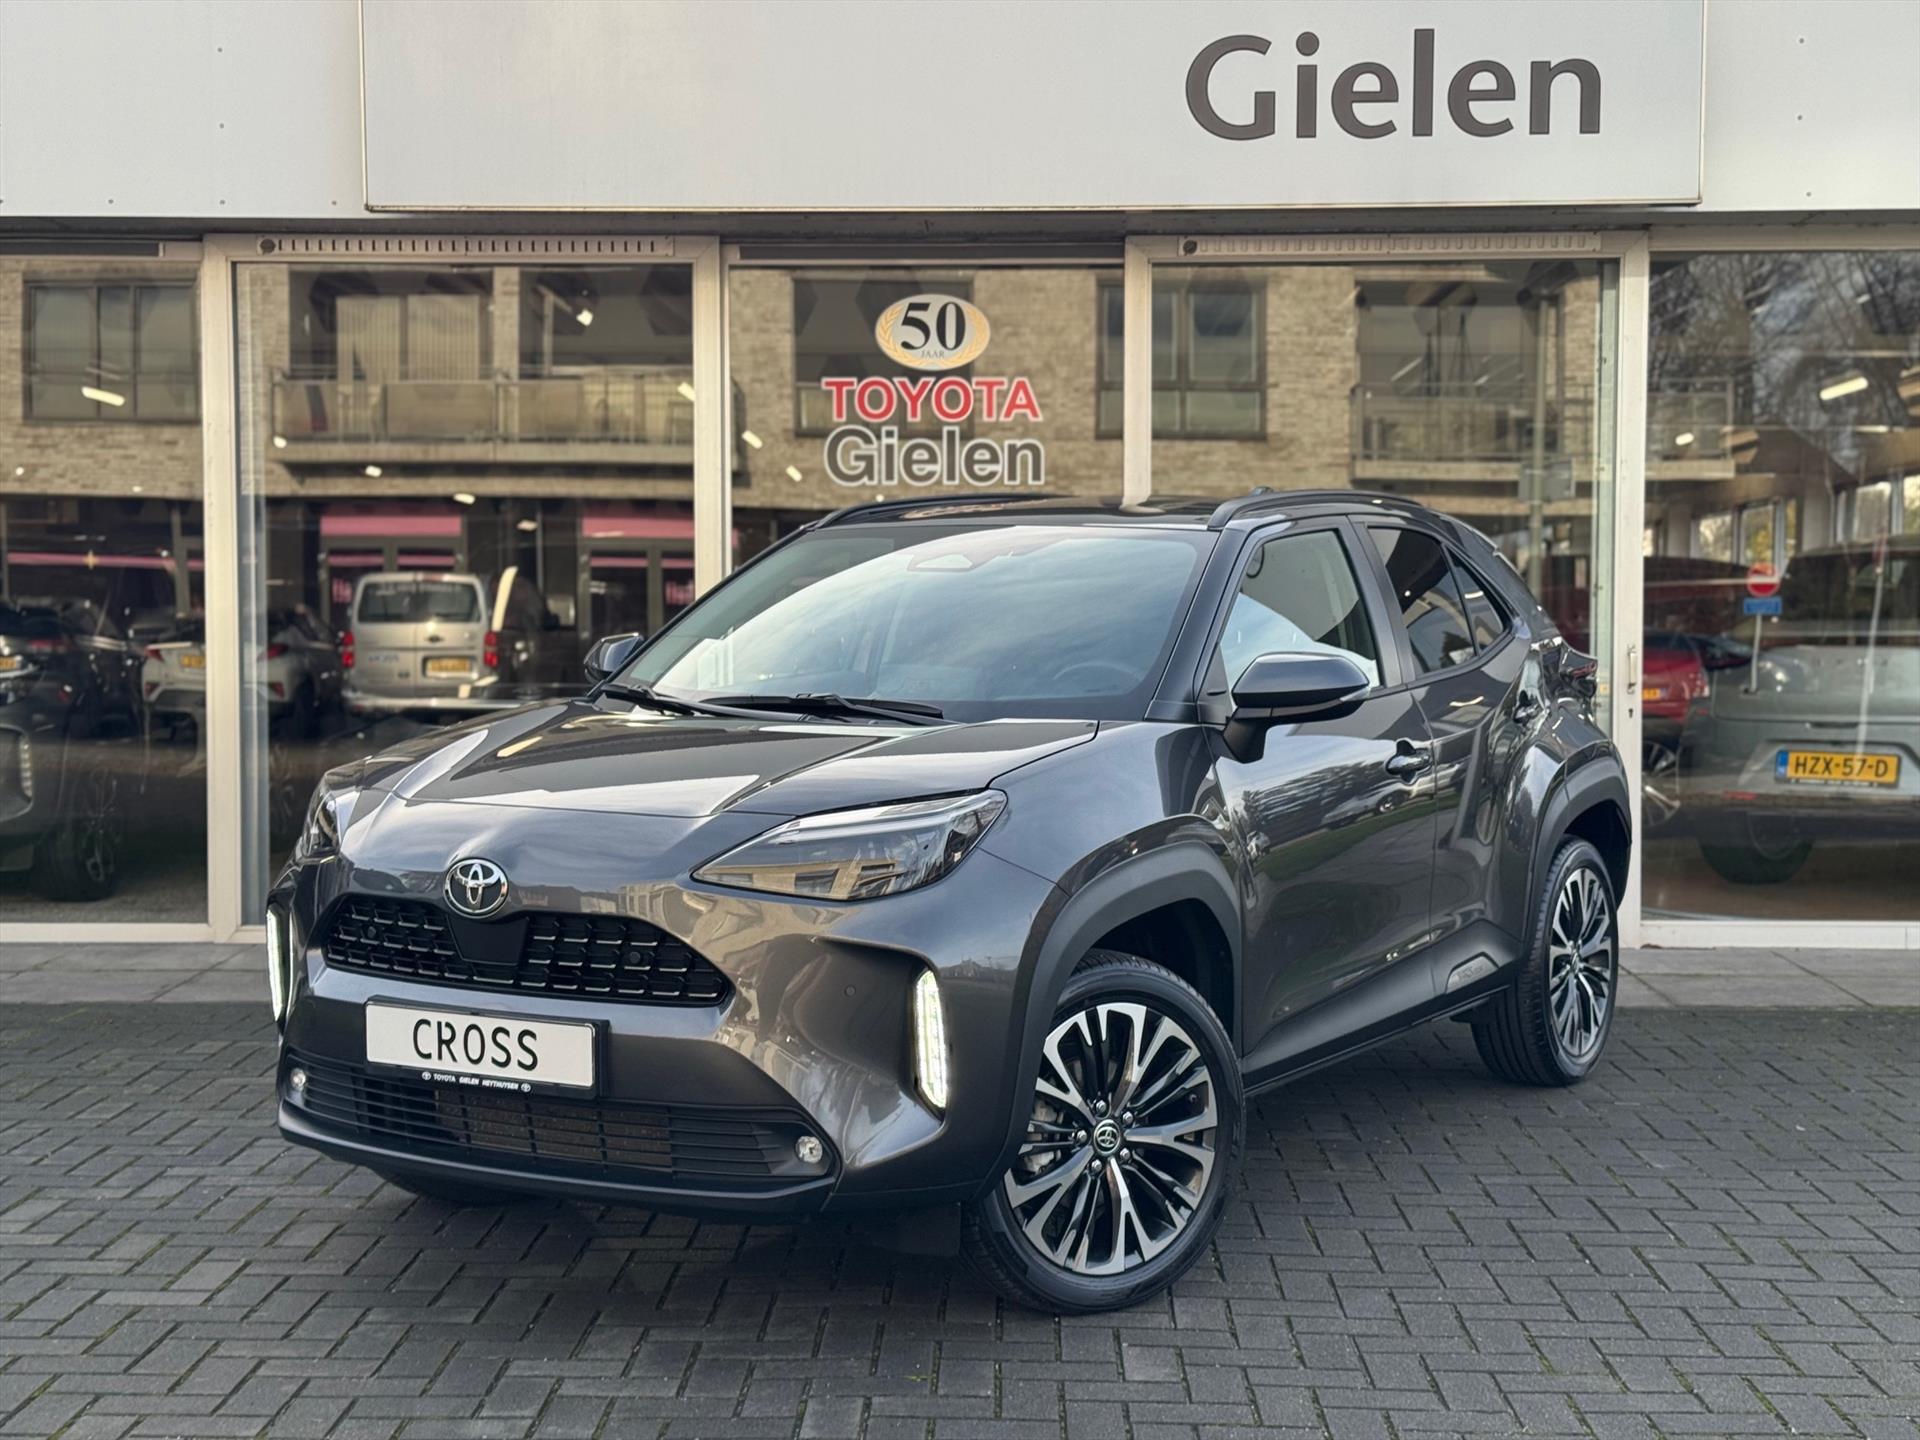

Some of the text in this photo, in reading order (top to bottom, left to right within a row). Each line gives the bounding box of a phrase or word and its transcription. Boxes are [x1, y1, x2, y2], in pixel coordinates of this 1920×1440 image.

[1185, 28, 1601, 141] Gielen
[900, 301, 966, 351] 50
[821, 376, 1043, 422] TOYOTA
[824, 424, 1045, 487] Gielen
[1794, 756, 1889, 778] HZX-57-D
[412, 1018, 538, 1071] CROSS
[433, 1073, 456, 1082] TOYOTA
